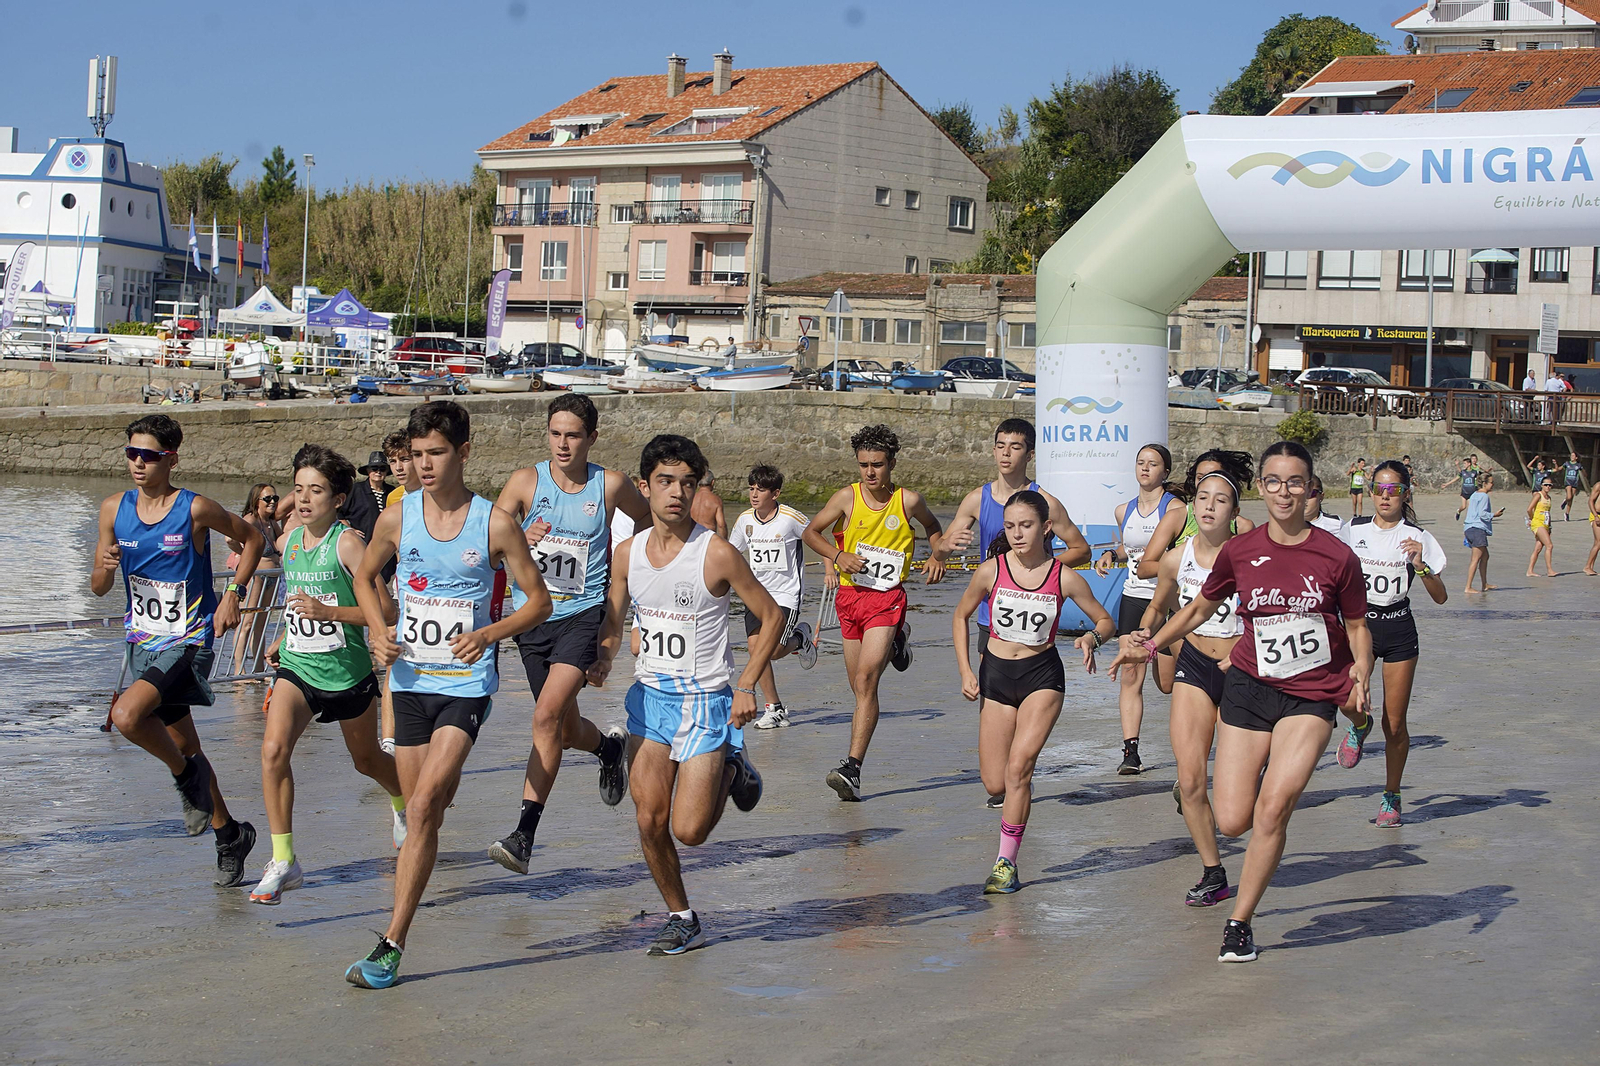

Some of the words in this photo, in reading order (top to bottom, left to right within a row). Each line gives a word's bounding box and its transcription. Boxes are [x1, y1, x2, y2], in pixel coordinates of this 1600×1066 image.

[1421, 137, 1594, 184] NIGRÁ
[1494, 195, 1566, 212] Equilibrio
[8, 252, 27, 305] ALQUILER
[491, 281, 505, 327] ESCUELA
[1302, 327, 1360, 339] Marisquería
[1377, 328, 1436, 339] Restaurane
[1043, 420, 1129, 443] NIGRÁN
[1050, 450, 1084, 460] Equilibrio
[1085, 449, 1120, 459] Natural
[164, 534, 183, 542] NICE
[555, 526, 579, 538] Saunier
[563, 540, 589, 548] AREA
[537, 551, 577, 579] 311
[753, 549, 781, 563] 317
[296, 570, 339, 583] MIGUEL
[432, 580, 460, 589] Saunier
[1363, 573, 1402, 595] 301
[133, 592, 181, 623] 303
[441, 599, 473, 610] AREA
[1032, 594, 1057, 603] AREA
[1247, 586, 1286, 612] Sella
[1287, 595, 1317, 612] cup
[667, 612, 696, 622] AREA
[996, 606, 1048, 633] 319
[1381, 607, 1408, 619] NIKE
[285, 612, 338, 638] 308
[403, 615, 464, 646] 304
[640, 626, 686, 660] 310
[1260, 629, 1320, 664] 315
